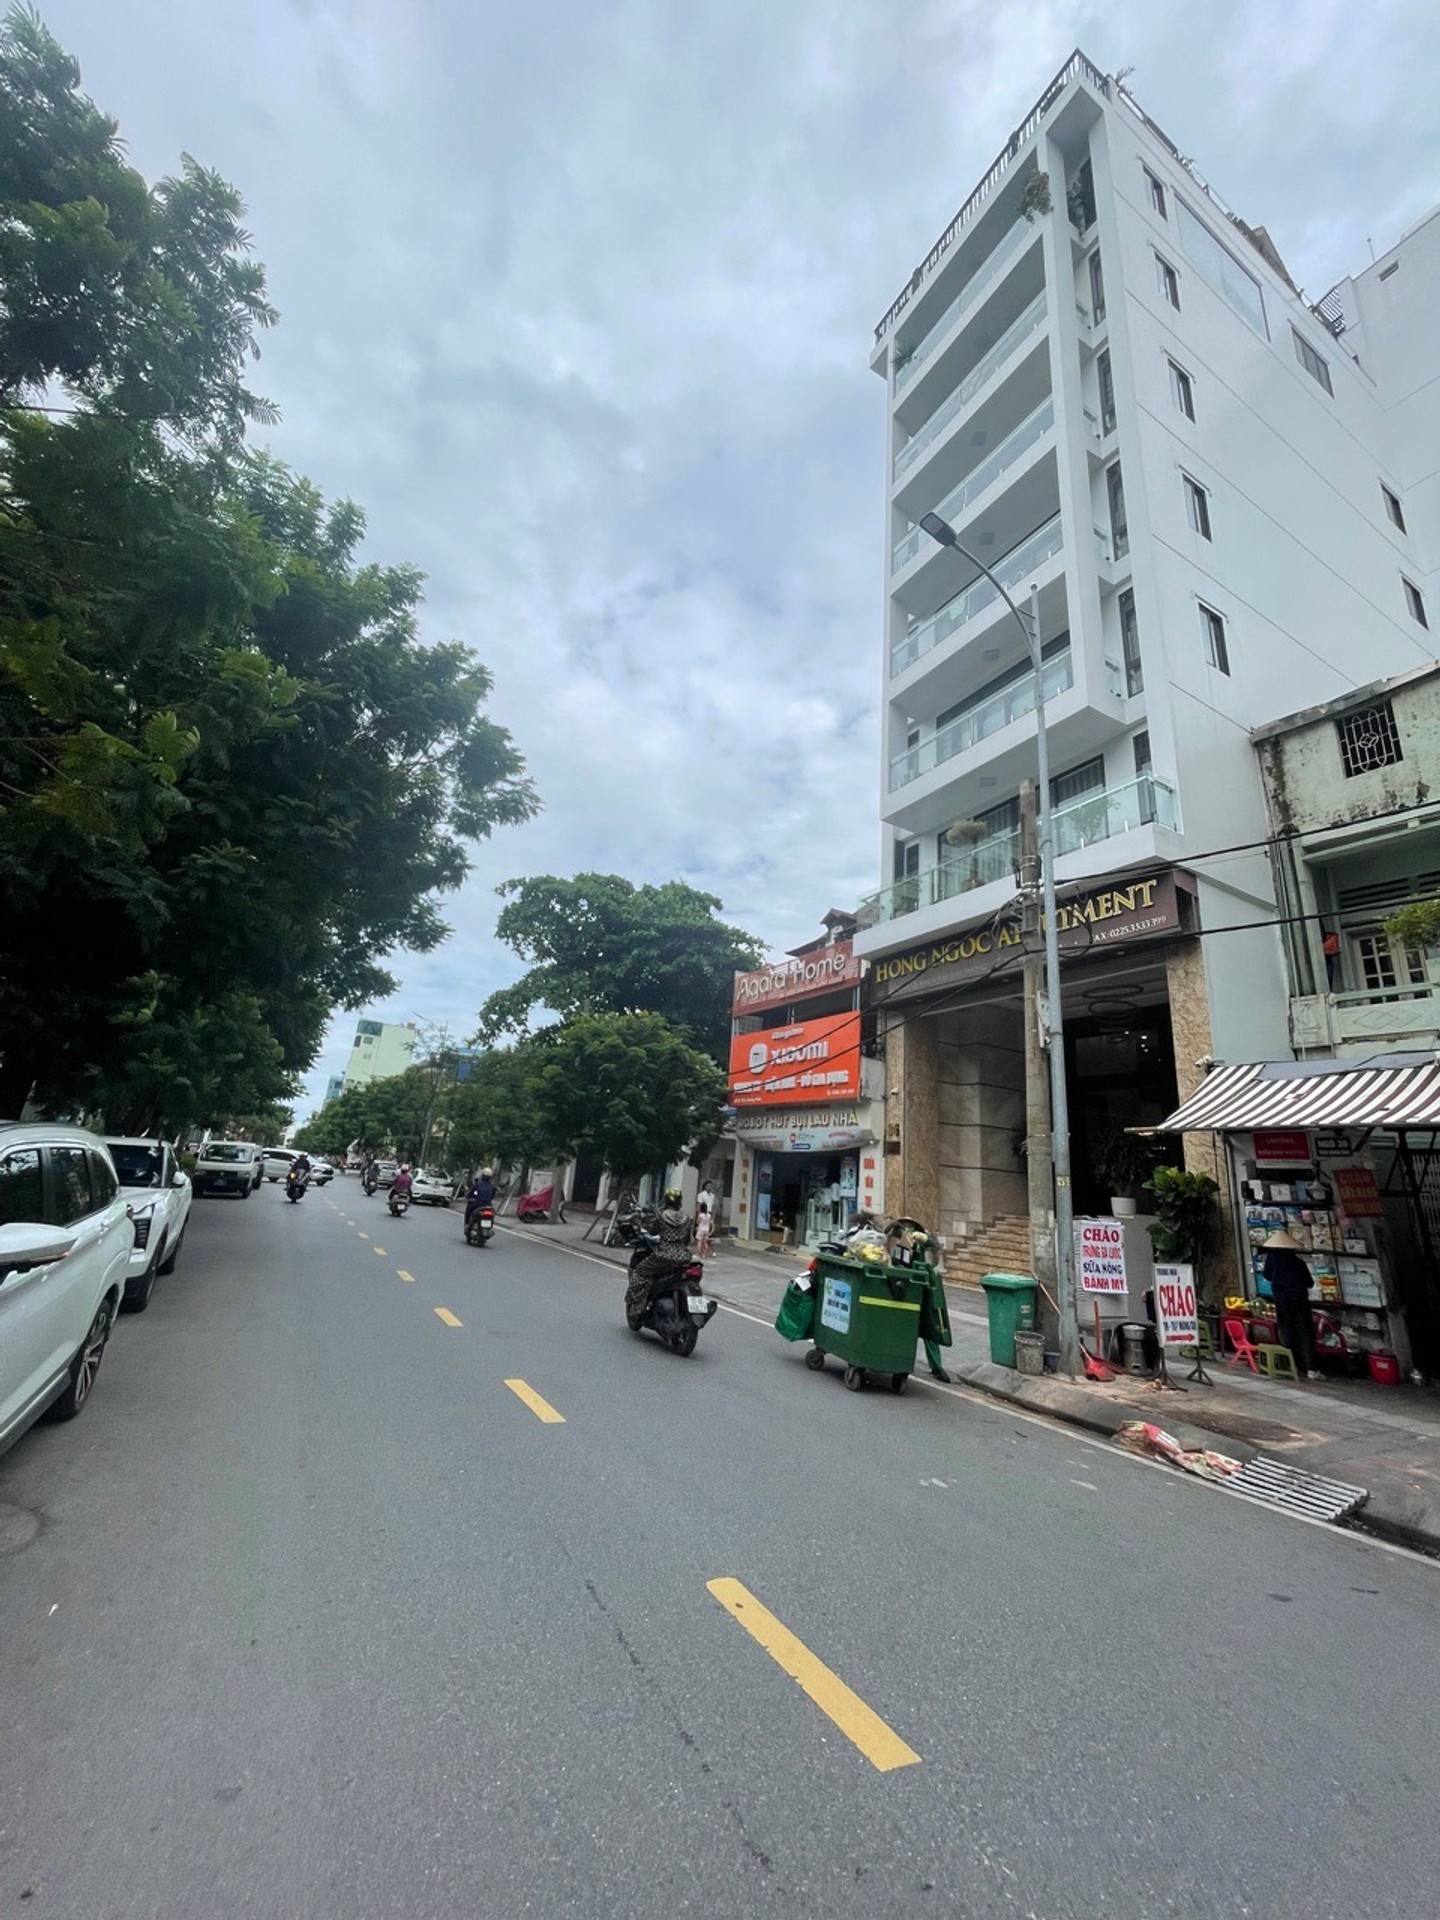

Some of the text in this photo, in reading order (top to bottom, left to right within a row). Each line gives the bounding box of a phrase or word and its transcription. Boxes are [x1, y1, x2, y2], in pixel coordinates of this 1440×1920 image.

[876, 949, 927, 983] HONG
[931, 932, 992, 968] NGOC
[998, 879, 1158, 948] ATMENT
[793, 952, 845, 984] Home
[770, 1041, 828, 1065] xiaomi
[1083, 1226, 1120, 1243] CHÁO
[1083, 1260, 1101, 1274] SỮA
[1083, 1275, 1109, 1289] BÁNH
[1159, 1276, 1195, 1317] CHÁO
